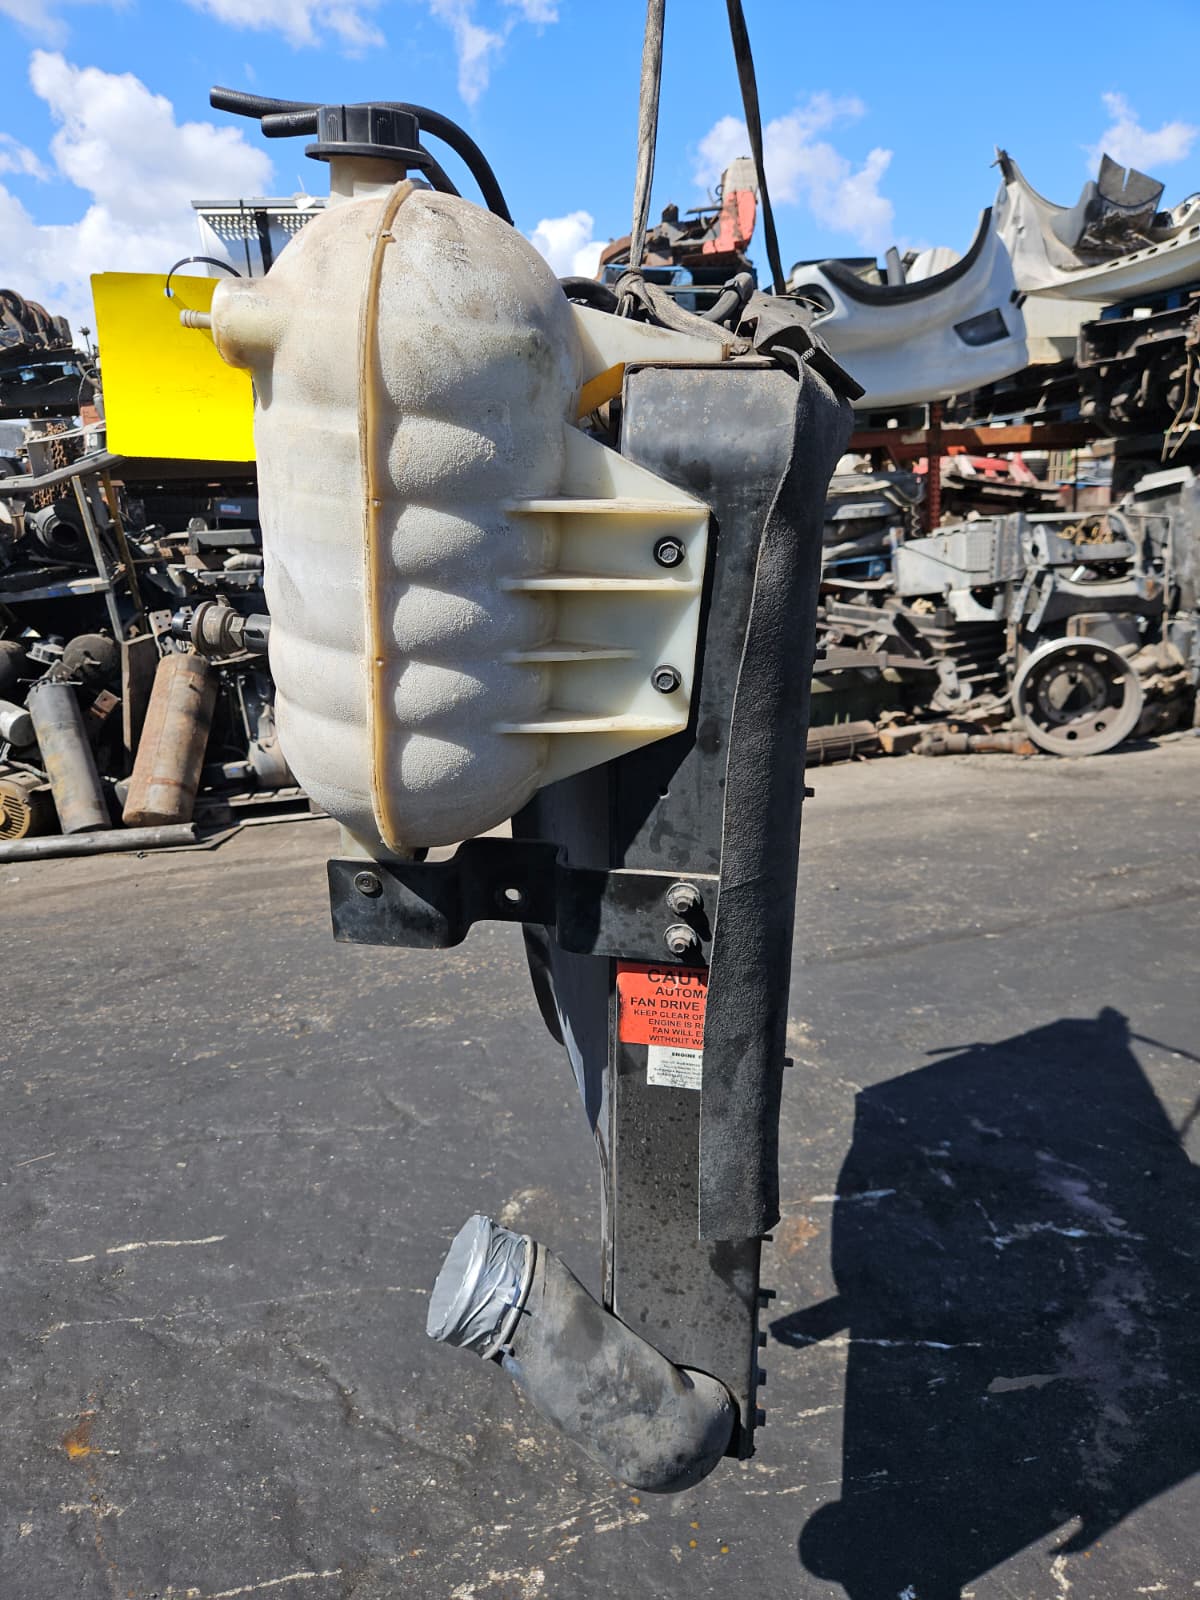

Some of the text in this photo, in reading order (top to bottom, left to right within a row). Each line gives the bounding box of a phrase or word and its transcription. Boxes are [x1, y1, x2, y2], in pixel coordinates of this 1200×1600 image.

[630, 996, 699, 1011] FAN DRIVE
[648, 1019, 682, 1027] ENGINE
[648, 1035, 688, 1044] WITHOUT
